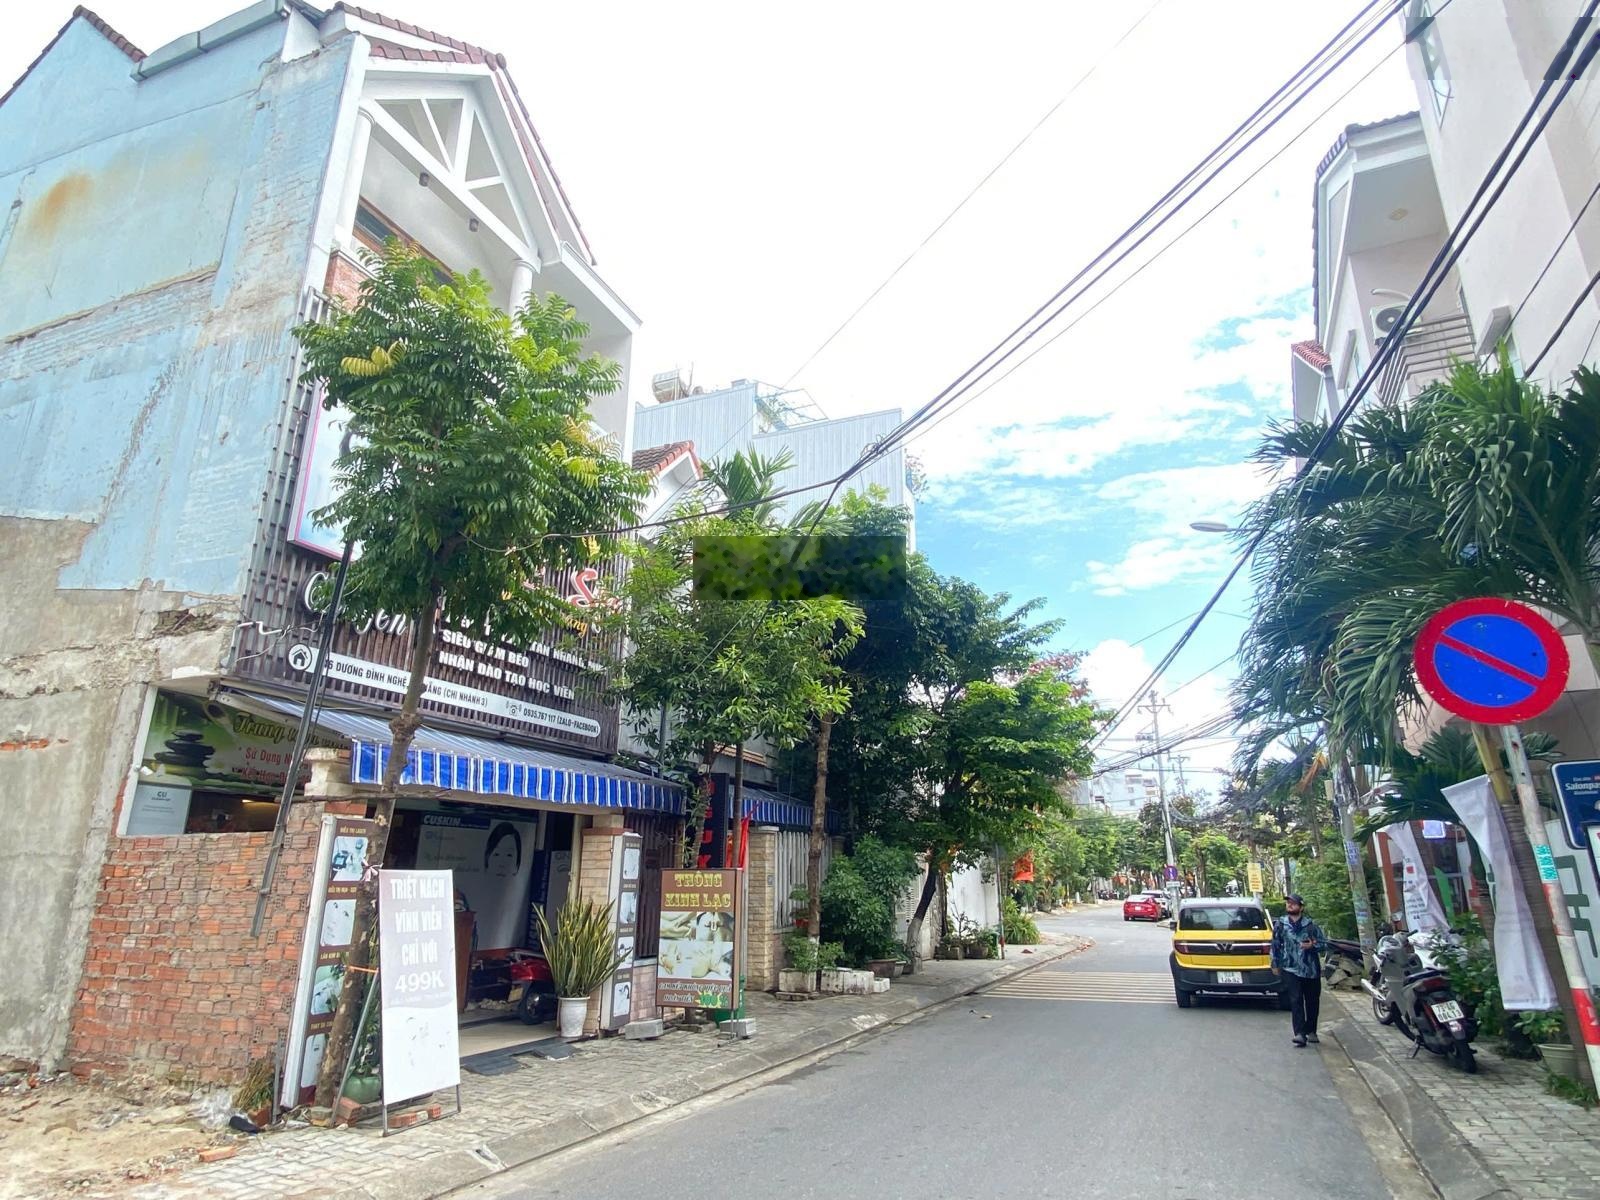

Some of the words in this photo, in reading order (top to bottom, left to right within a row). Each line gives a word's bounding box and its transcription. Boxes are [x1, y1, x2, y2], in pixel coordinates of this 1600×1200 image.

[442, 629, 472, 649] SIÊU
[508, 651, 530, 668] BÉO
[336, 660, 363, 679] DƯƠNG
[366, 667, 385, 682] ĐÌNH
[444, 685, 457, 699] (CHI
[459, 689, 481, 705] NHÁNH
[481, 696, 488, 708] 3)
[439, 651, 474, 671] NHẬN
[477, 663, 502, 680] ĐÀO
[505, 670, 526, 687] TẠO
[528, 678, 550, 694] HỌC
[553, 685, 575, 700] VIÊN
[233, 711, 285, 744] Trung
[557, 715, 598, 734] (ZALO-FACEBOOK)
[423, 814, 461, 826] CUSKIN
[674, 870, 722, 887] THÔNG
[664, 893, 700, 907] KINH
[703, 893, 731, 910] LẠC
[394, 970, 445, 993] 499K
